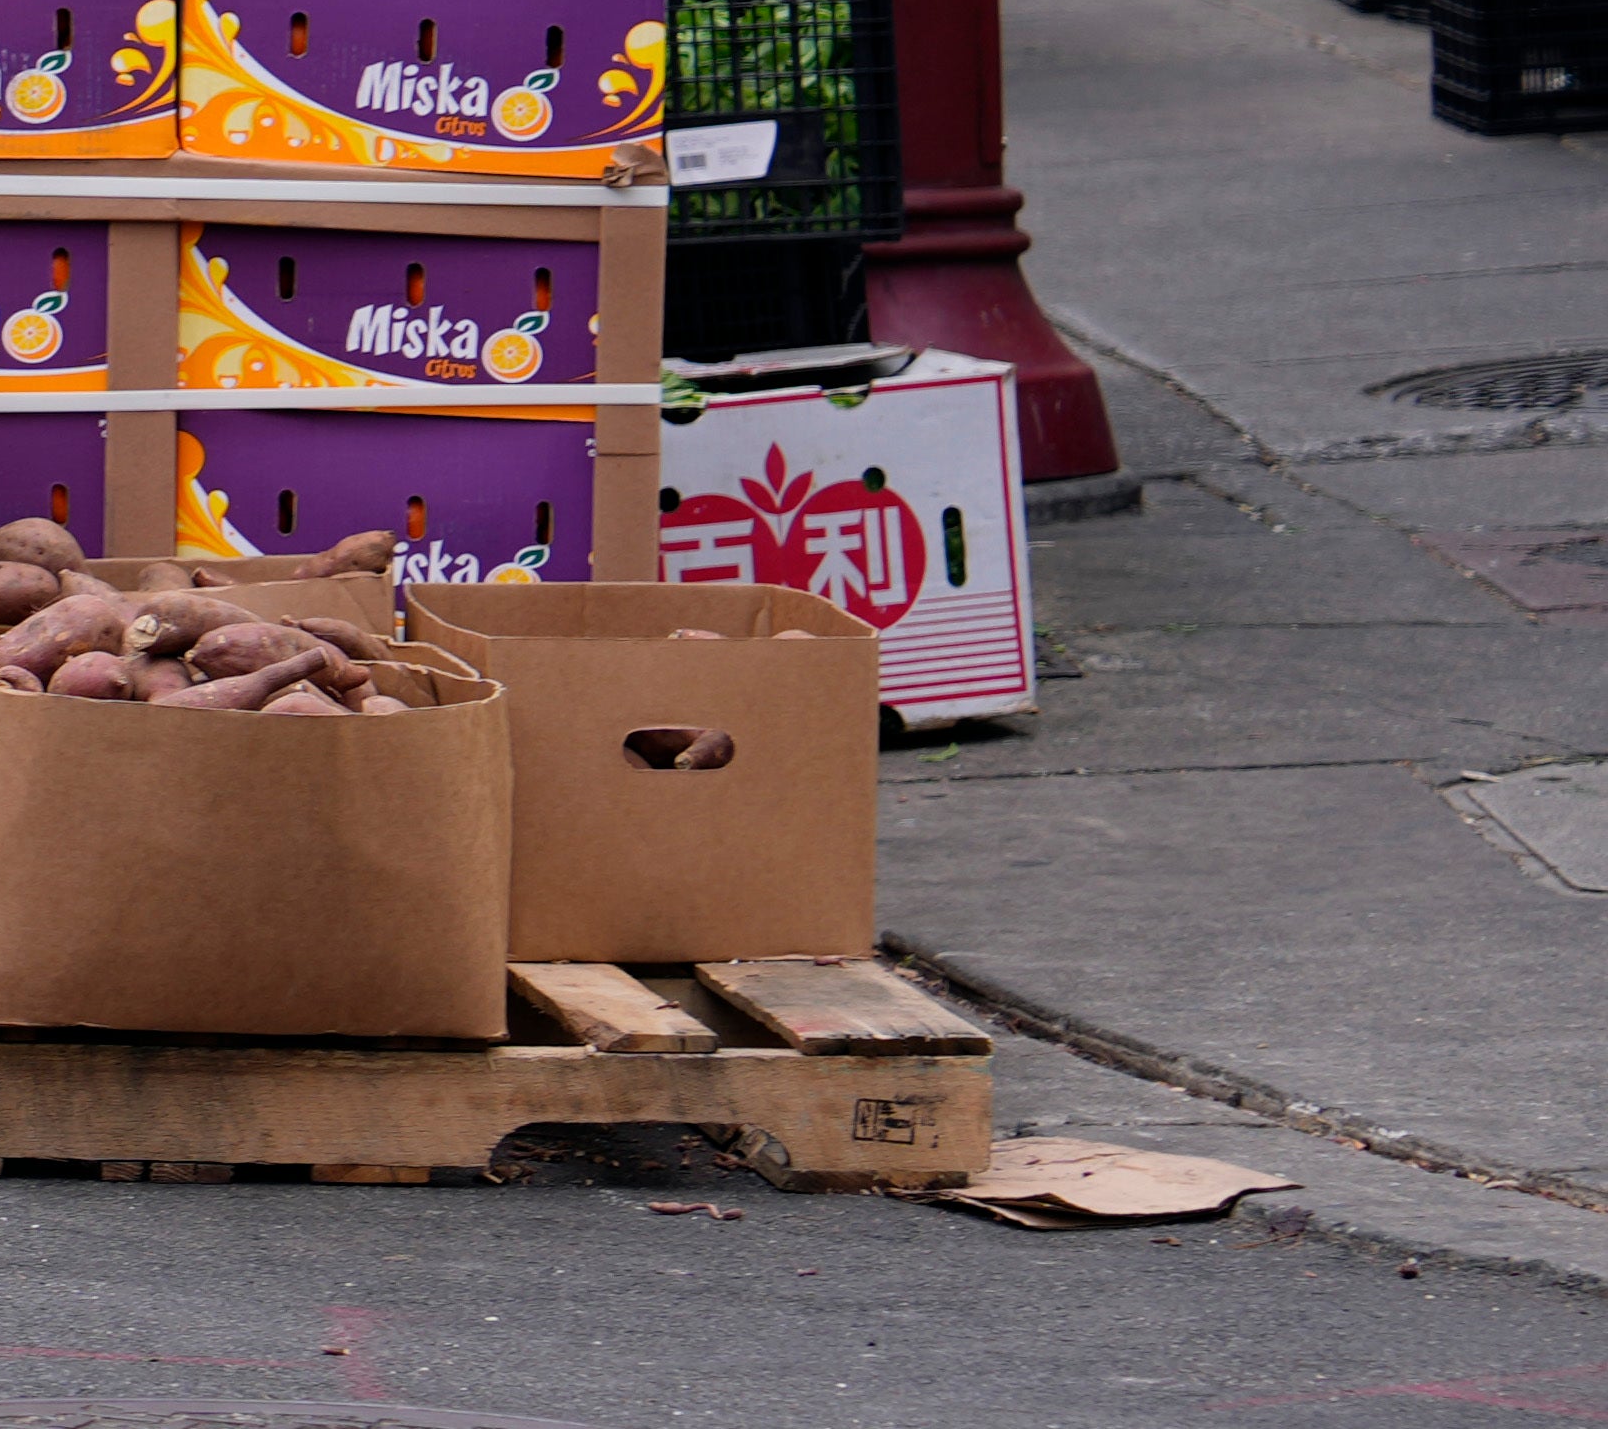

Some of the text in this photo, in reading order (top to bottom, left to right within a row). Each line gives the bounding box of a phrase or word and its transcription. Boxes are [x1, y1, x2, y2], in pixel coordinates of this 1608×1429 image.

[356, 61, 489, 118] Miska
[434, 115, 487, 138] Citrus
[345, 302, 480, 361] Miska
[424, 358, 478, 381] Citrus
[394, 541, 480, 583] iska
